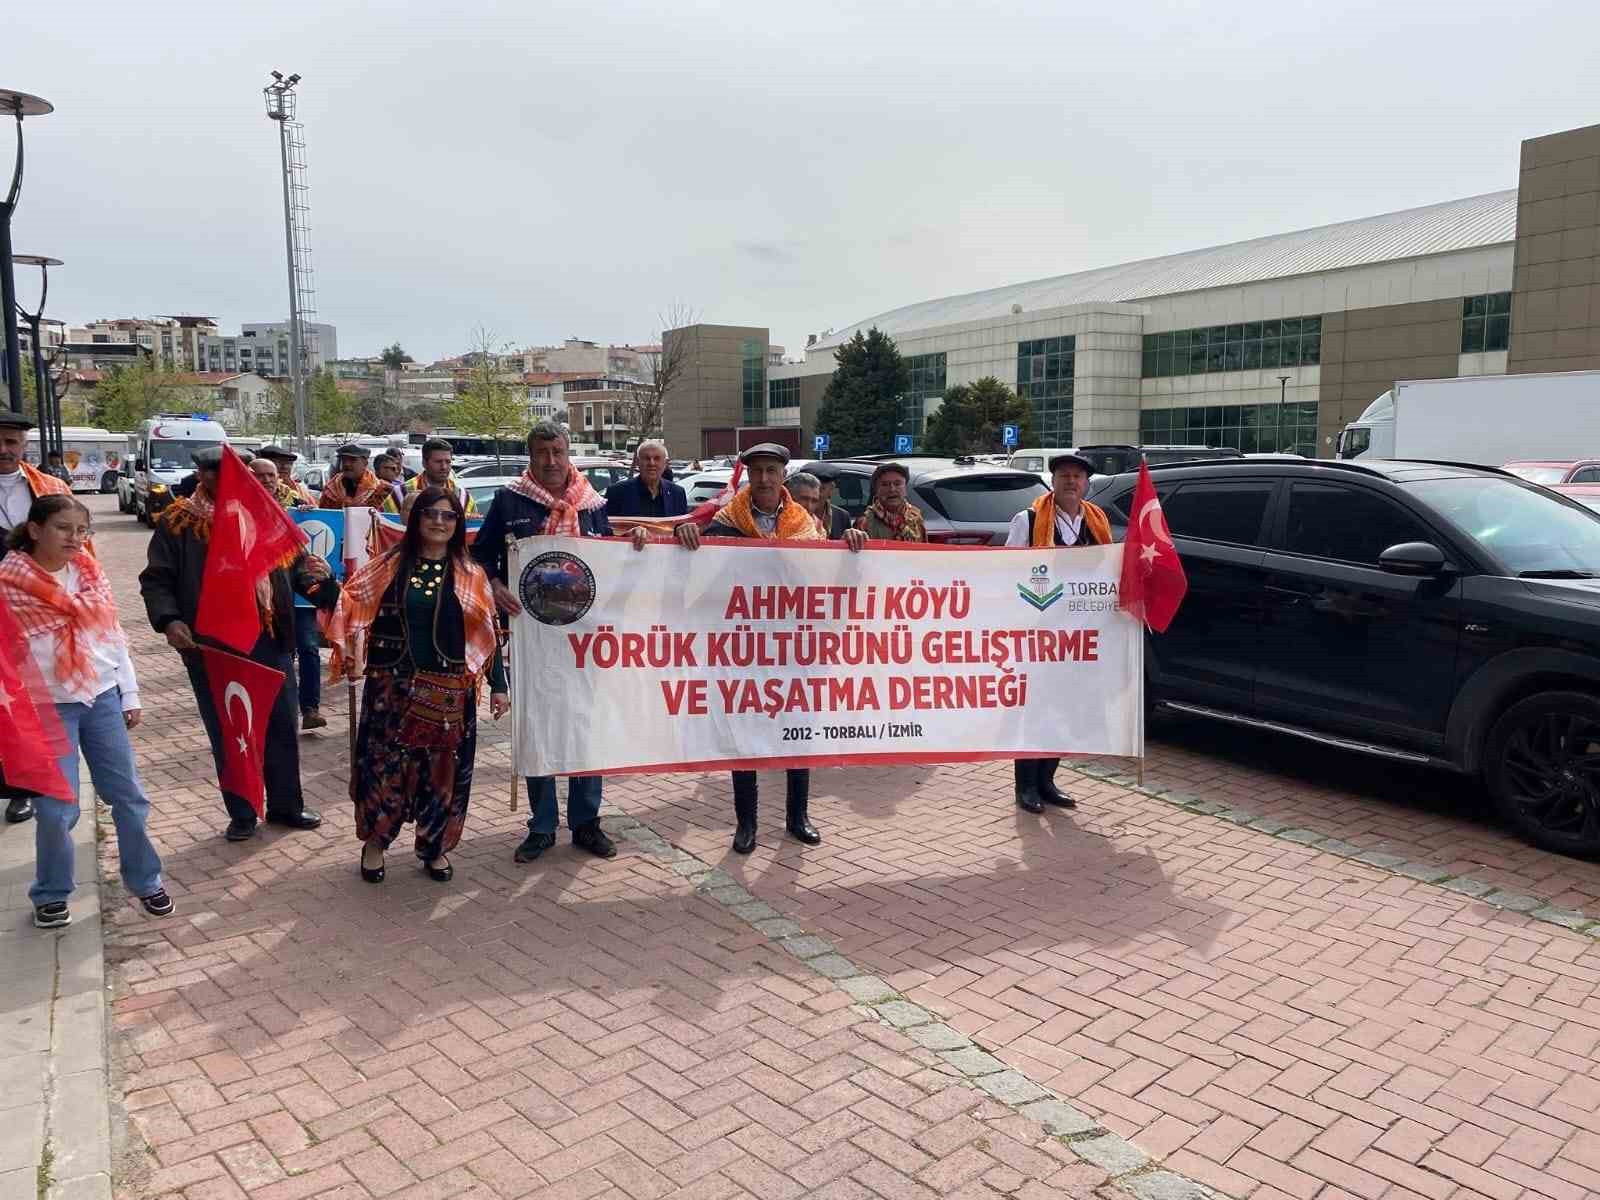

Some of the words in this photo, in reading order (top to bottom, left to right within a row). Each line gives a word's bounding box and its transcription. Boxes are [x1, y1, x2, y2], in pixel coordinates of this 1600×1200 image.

[815, 436, 824, 450] P
[899, 436, 908, 452] P
[1005, 427, 1014, 444] P
[1067, 582, 1121, 596] TORBA
[884, 580, 970, 619] KÖYÜ
[568, 625, 697, 669] YÖRÜK
[707, 624, 912, 668] KÜLTÜRÜNÜ
[661, 680, 708, 716] VE
[717, 677, 880, 719] YAŞATMA
[782, 727, 812, 741] 2012
[888, 721, 923, 738] İZMİR
